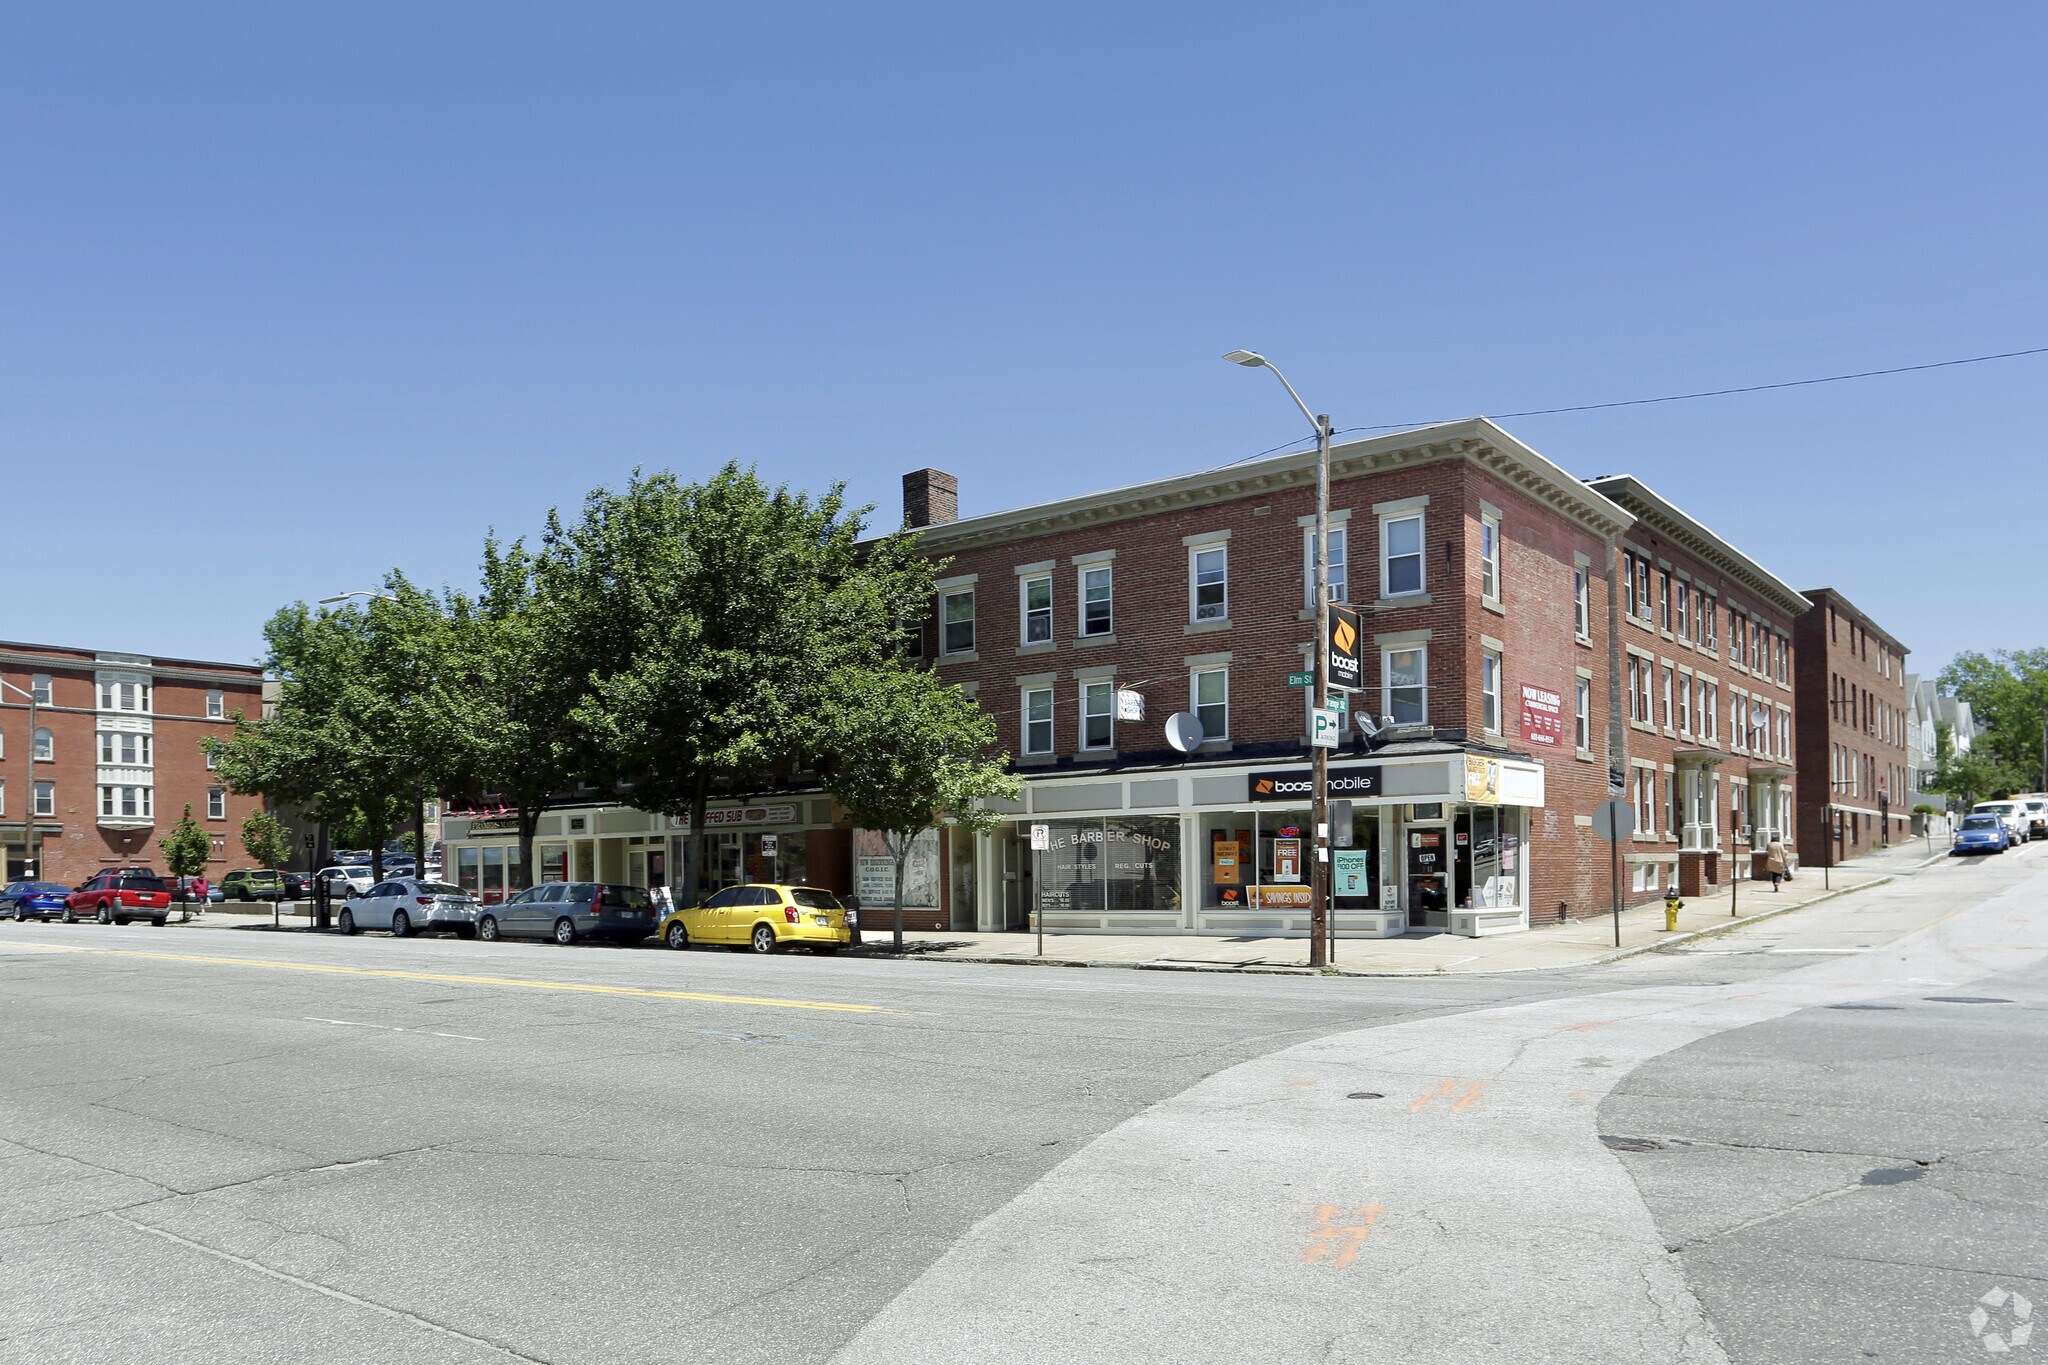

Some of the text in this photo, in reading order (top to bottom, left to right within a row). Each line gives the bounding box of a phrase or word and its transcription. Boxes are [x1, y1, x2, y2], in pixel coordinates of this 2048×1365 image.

[1331, 651, 1358, 673] boost
[1289, 674, 1313, 685] Elm St
[1338, 669, 1354, 680] mobile
[1522, 686, 1561, 707] NOW LEASING
[1547, 705, 1559, 713] SPACE
[1274, 780, 1312, 792] boos
[726, 810, 742, 822] SUB
[1071, 831, 1125, 845] BARBER
[1132, 833, 1171, 851] SHOP
[1277, 848, 1298, 857] FREE
[1421, 854, 1434, 862] OPEN
[1265, 891, 1311, 904] SAVINGS INSID
